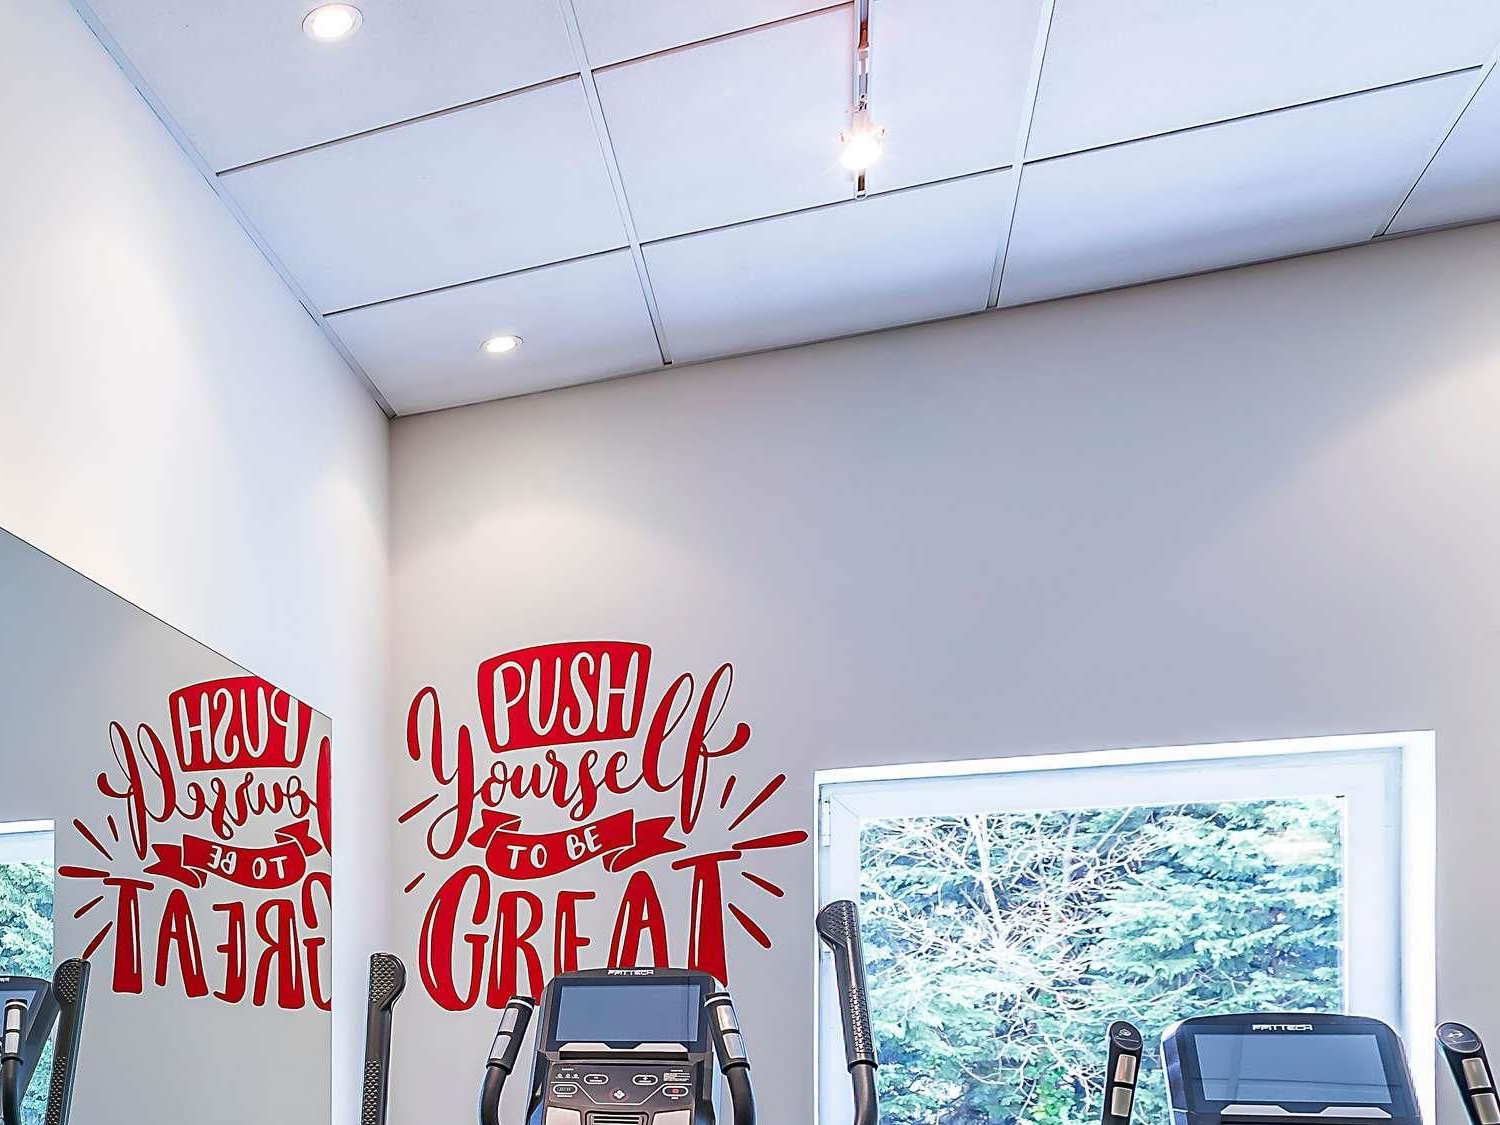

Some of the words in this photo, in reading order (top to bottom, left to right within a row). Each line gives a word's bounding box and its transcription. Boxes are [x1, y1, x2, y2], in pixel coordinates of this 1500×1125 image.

[491, 651, 640, 747] PUSH
[406, 662, 751, 860] Yourself
[506, 844, 547, 870] TO
[566, 825, 603, 861] BE
